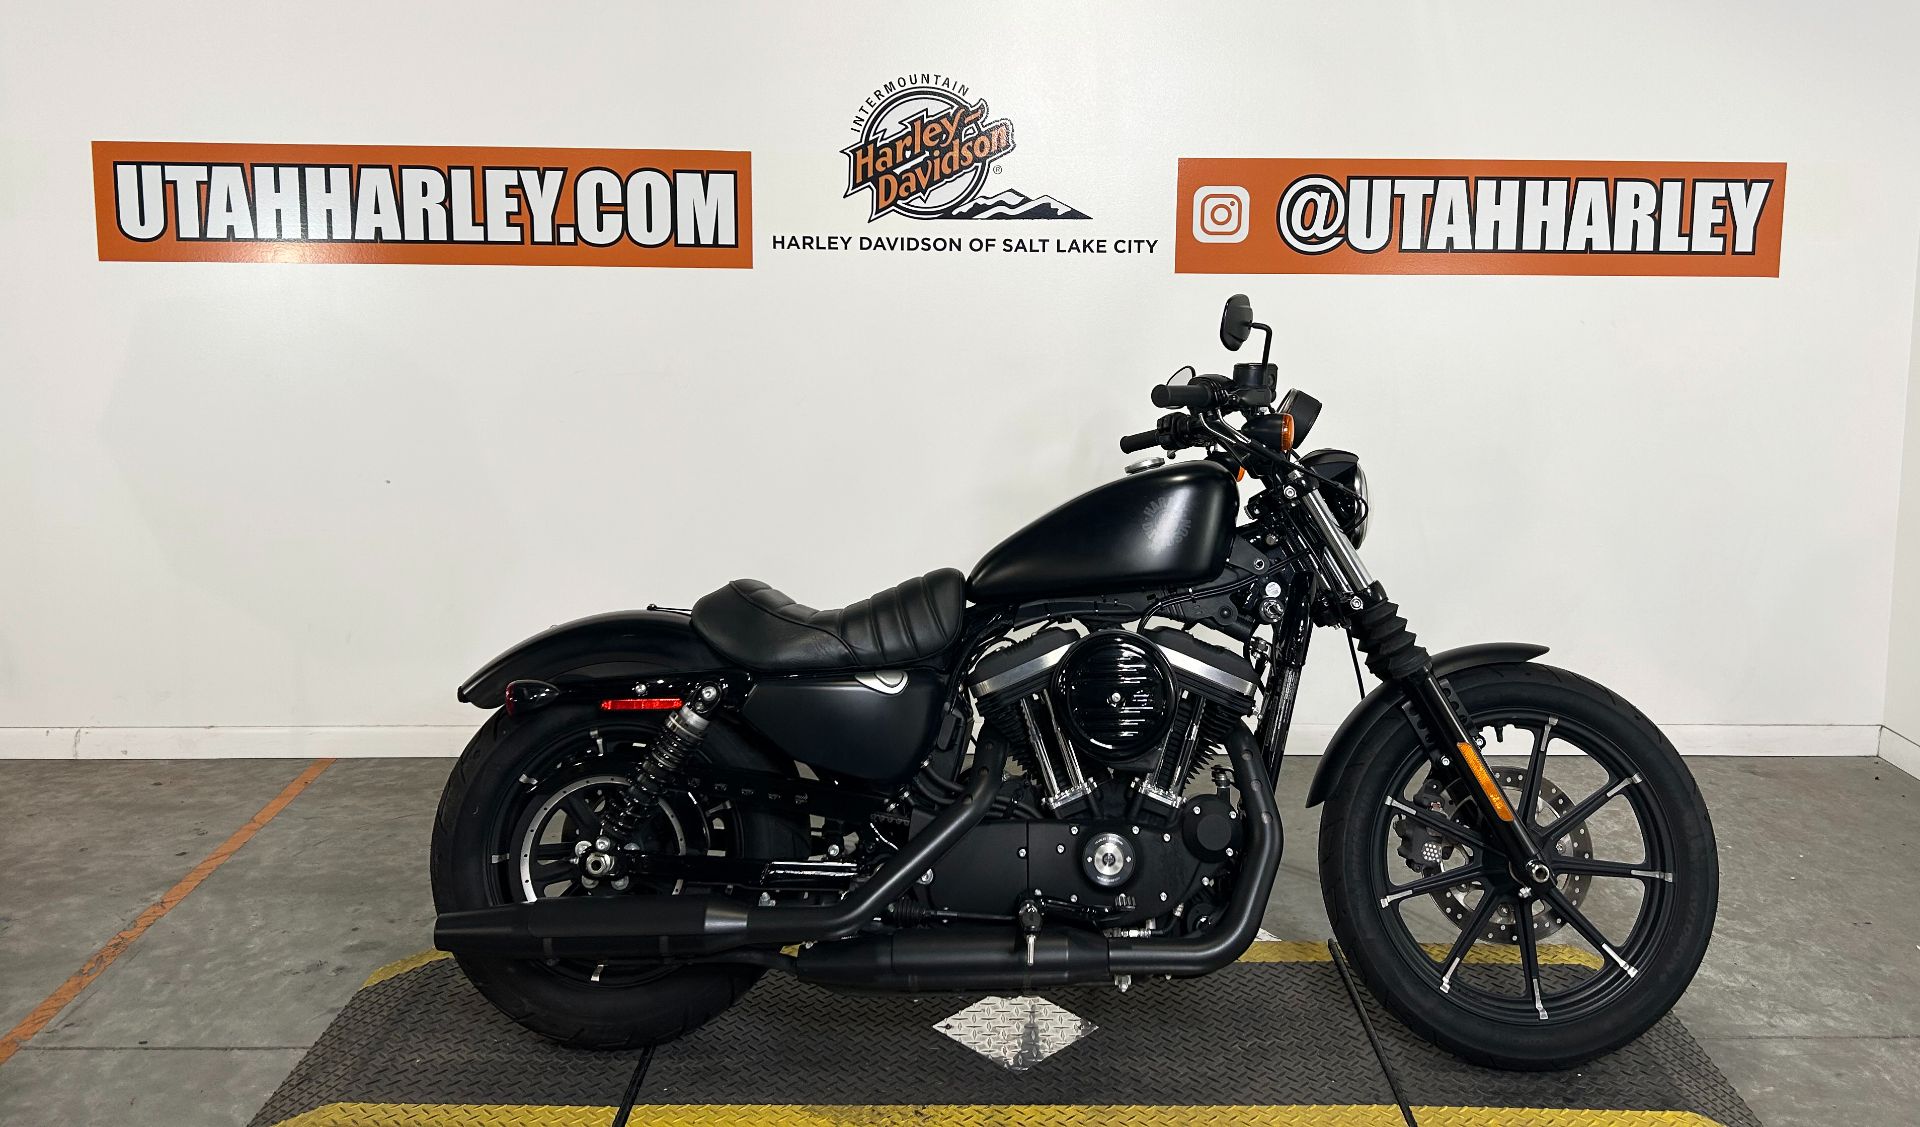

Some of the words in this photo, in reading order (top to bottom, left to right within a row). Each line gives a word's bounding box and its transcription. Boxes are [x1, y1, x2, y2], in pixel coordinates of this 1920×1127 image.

[850, 73, 970, 133] INTERMOUNTAIN
[113, 161, 739, 248] UTAHHARLEY.COM
[877, 125, 1009, 210] Davidson
[772, 235, 853, 250] HARLEY
[859, 236, 962, 252] DAVIDSON
[968, 238, 997, 252] OF
[1002, 238, 1050, 253] SALT
[1056, 239, 1107, 253] LAKE
[1113, 239, 1159, 254] CITY
[1276, 174, 1774, 255] @UTAHHARLEY
